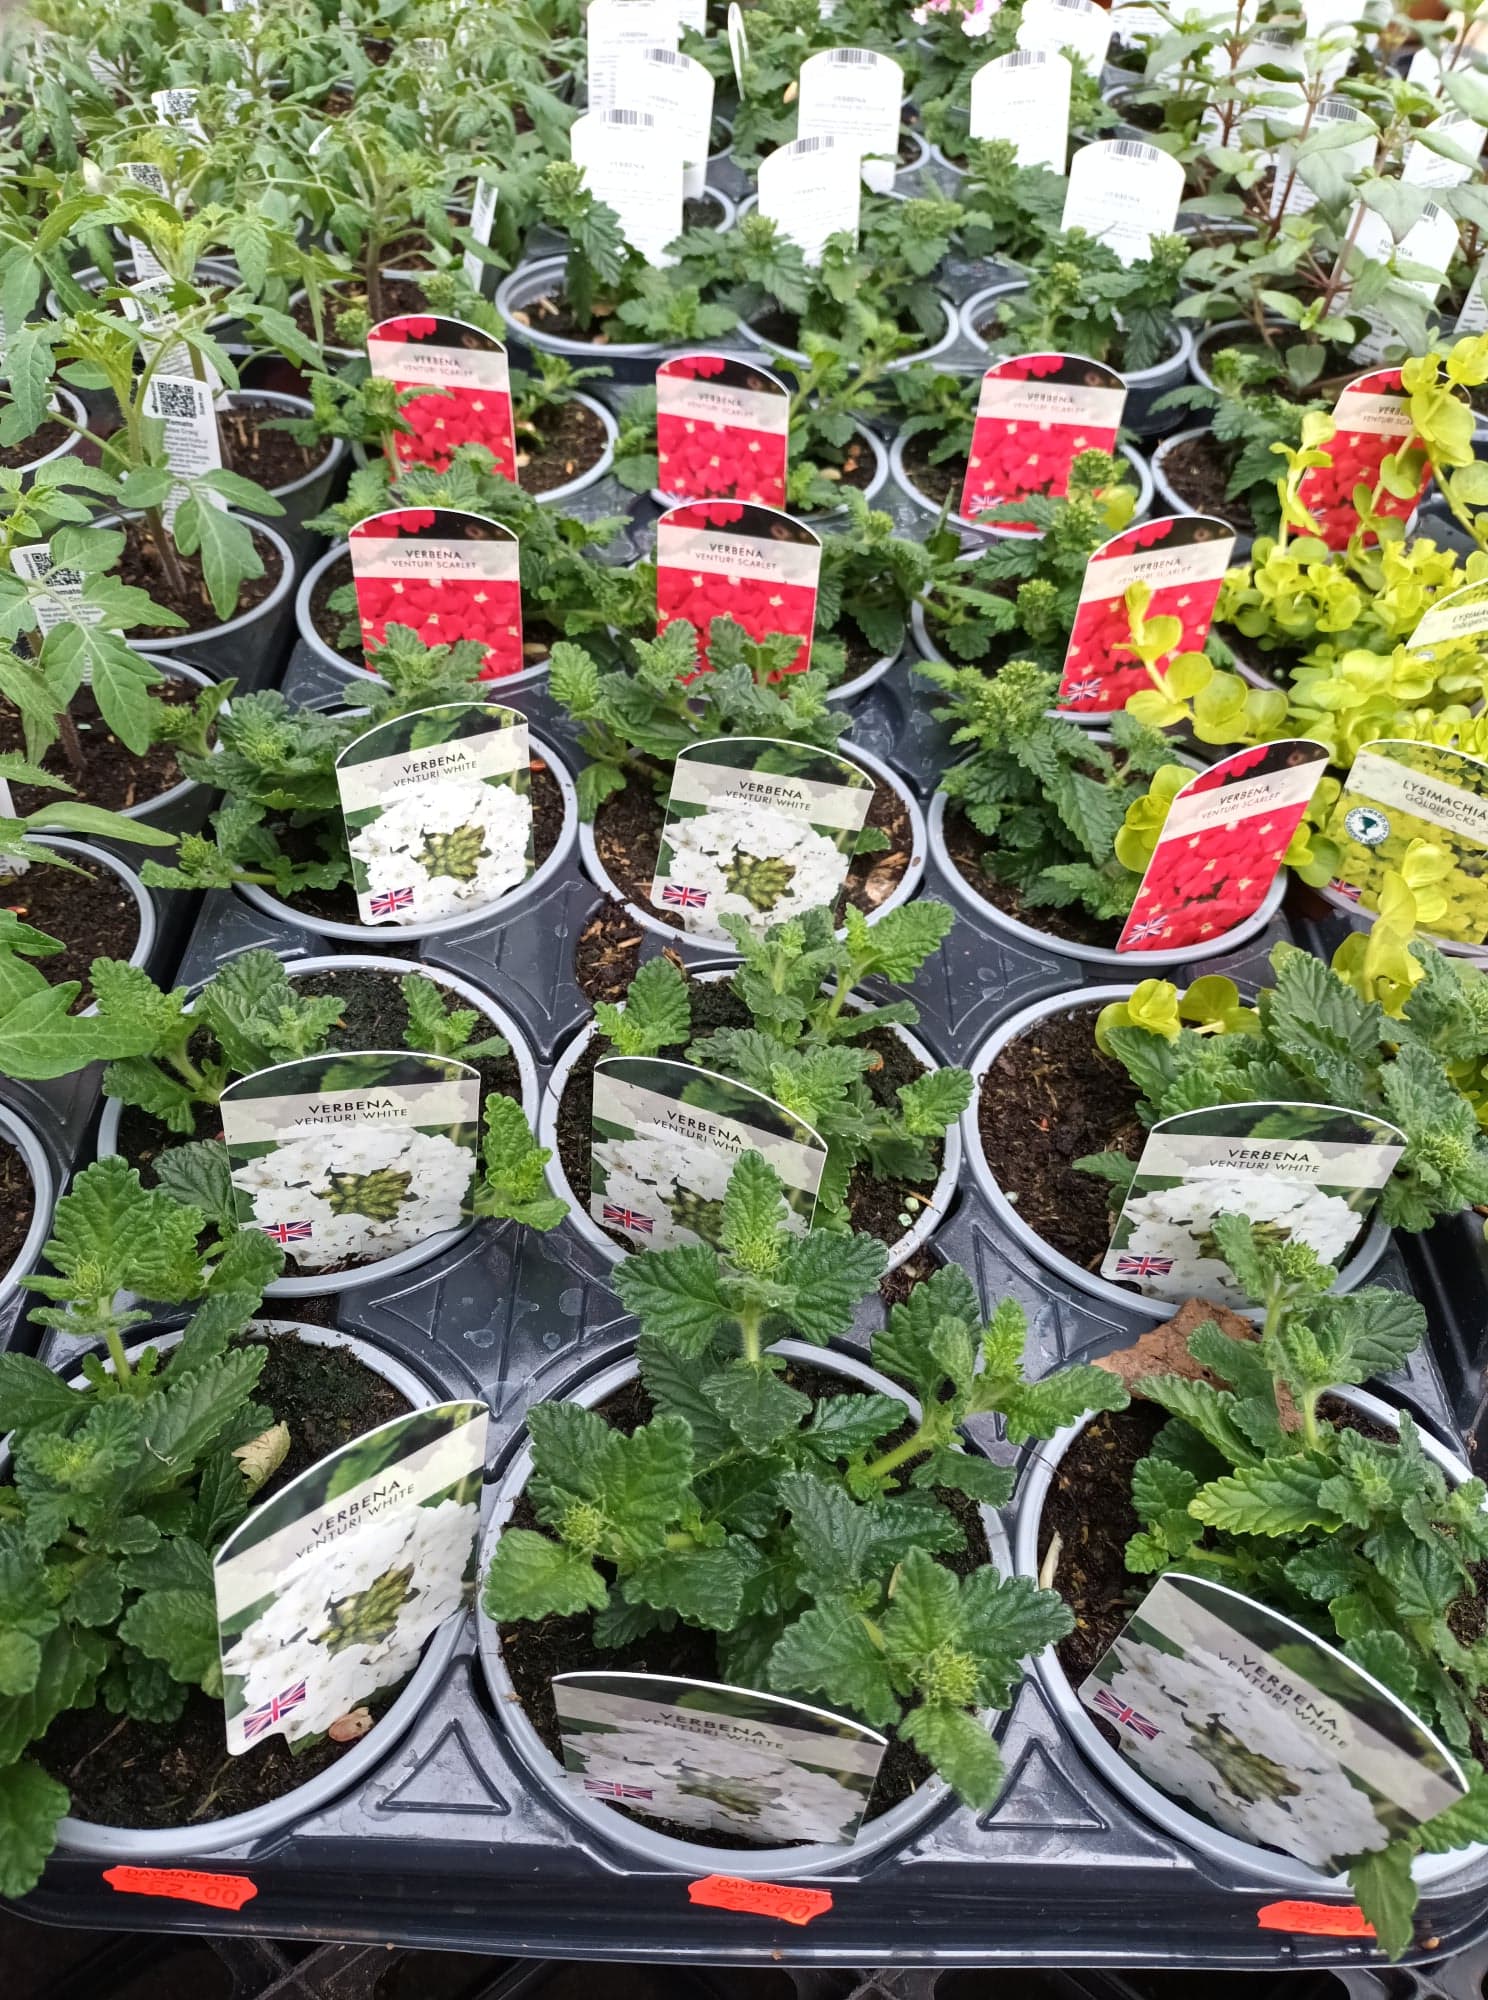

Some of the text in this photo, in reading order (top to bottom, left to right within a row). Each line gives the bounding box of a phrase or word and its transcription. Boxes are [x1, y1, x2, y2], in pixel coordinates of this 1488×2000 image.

[413, 354, 461, 367] VERBENA
[697, 392, 744, 406] VERBENA
[1027, 391, 1075, 404] VERBENA
[406, 549, 463, 560] VERBENA
[709, 543, 764, 559] VERBENA
[391, 560, 477, 569] VENTURI SCARLET
[695, 553, 777, 570] VENTURI SCARLET
[1132, 557, 1183, 573] VERBENA
[402, 752, 467, 774] VERBENA
[393, 760, 478, 788] VENTURI WHITE
[738, 781, 803, 800] VERBENA
[1219, 785, 1271, 804] VERBENA
[725, 790, 812, 812] VENTURI WHITE
[1201, 791, 1281, 820] VENTURI SCARLET
[1402, 780, 1488, 821] LYSIMACHIA
[1405, 793, 1477, 827] GOLDILOCKS
[308, 1099, 394, 1115] VERBENA
[294, 1108, 409, 1127] VENTURI WHITE
[652, 1117, 746, 1154] VENTURI WHIT
[666, 1110, 743, 1145] VERBENA
[1228, 1149, 1310, 1163] VERBENA
[1208, 1158, 1321, 1174] VENTURI WHITE
[310, 1480, 402, 1537] VERBENA
[295, 1482, 416, 1560] VENTURI WHITE
[1218, 1651, 1348, 1750] VENTURI WHITE
[1243, 1653, 1338, 1732] VERBENA
[642, 1717, 784, 1750] VENTURI WHITE
[659, 1711, 768, 1739] VERBENA
[213, 1875, 242, 1884] DIY
[796, 1889, 824, 1900] DIY
[1290, 1917, 1373, 1932] £2.0
